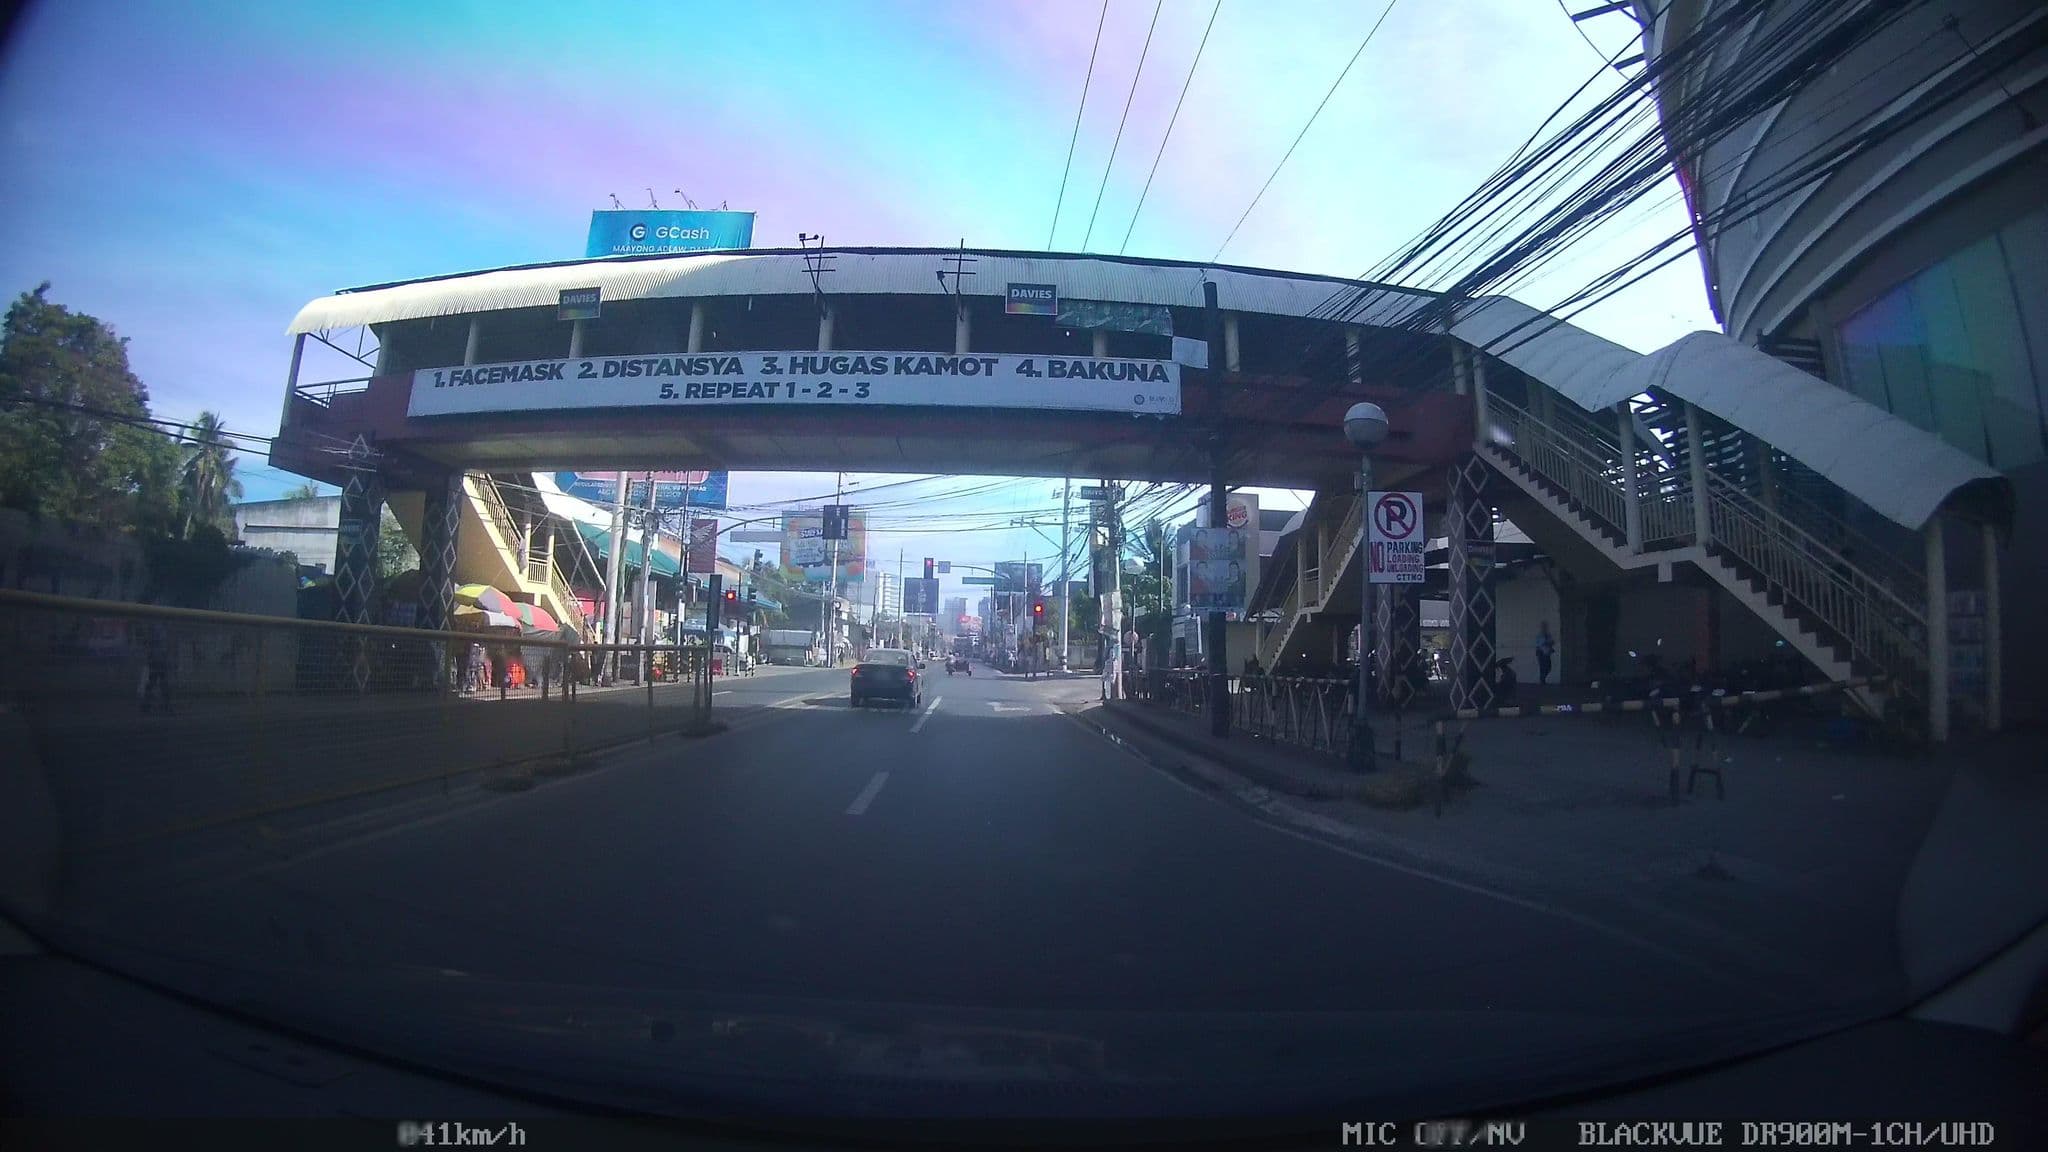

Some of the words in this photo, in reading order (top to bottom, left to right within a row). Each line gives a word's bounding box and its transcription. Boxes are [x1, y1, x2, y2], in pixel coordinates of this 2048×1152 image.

[655, 226, 710, 239] GCash
[563, 294, 597, 304] DAVIES
[1011, 289, 1052, 299] DAVIES
[434, 371, 447, 388] 1.
[450, 363, 566, 386] FACEMASK
[578, 363, 598, 379] 2.
[602, 357, 744, 379] DISTANSYA
[760, 357, 783, 375] 3.
[789, 356, 888, 376] HUGAS
[893, 357, 999, 377] KAMOT
[1015, 359, 1043, 378] 4.
[1047, 360, 1170, 384] BAKUNA
[659, 384, 679, 399] 5.
[685, 382, 780, 399] REPEAT
[1386, 542, 1423, 553] PARKING
[1370, 542, 1384, 573] NO
[1387, 554, 1419, 563] LOADING
[1387, 564, 1424, 572] UNLOADING
